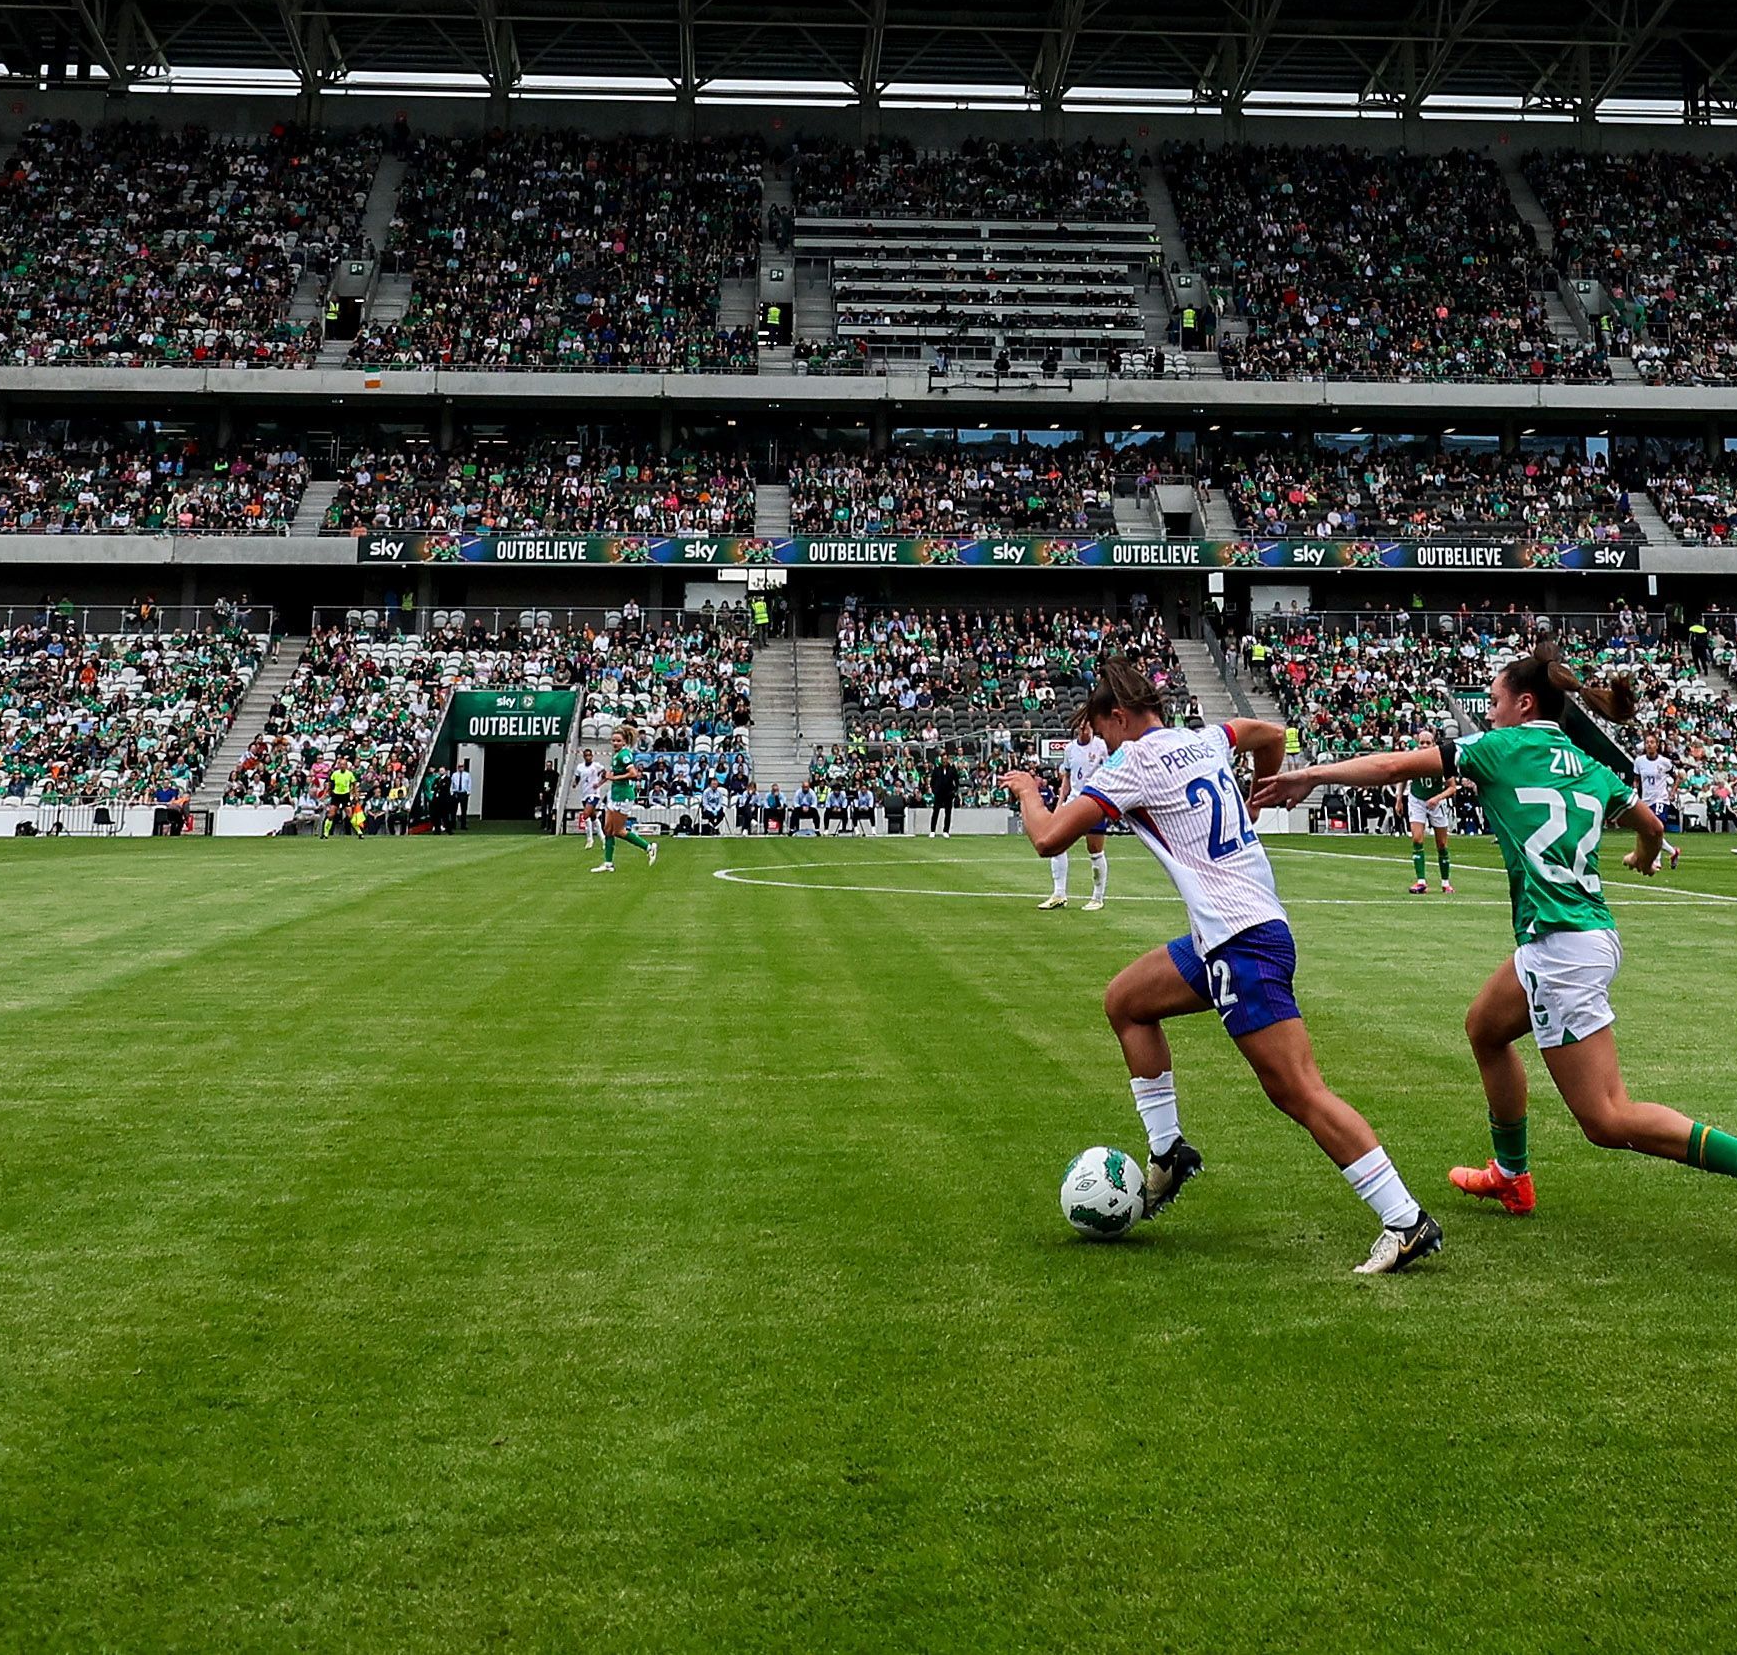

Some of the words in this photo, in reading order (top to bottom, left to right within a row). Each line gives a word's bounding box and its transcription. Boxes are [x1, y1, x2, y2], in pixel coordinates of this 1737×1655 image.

[369, 541, 404, 560] sky
[496, 541, 587, 561] OUTBELIEVE
[684, 541, 718, 562] sky
[808, 542, 898, 562] OUTBELIEVE
[992, 542, 1026, 563] sky
[1112, 544, 1200, 564] OUTBELIEVE
[1293, 545, 1326, 566] sky
[1416, 546, 1503, 567] OUTBELIEVE
[1594, 547, 1626, 568] sky
[496, 695, 516, 708] sky
[469, 716, 561, 736] OUTBELIEVE
[1077, 767, 1083, 781] 6
[1185, 767, 1259, 862] 22
[1515, 787, 1604, 893] 22
